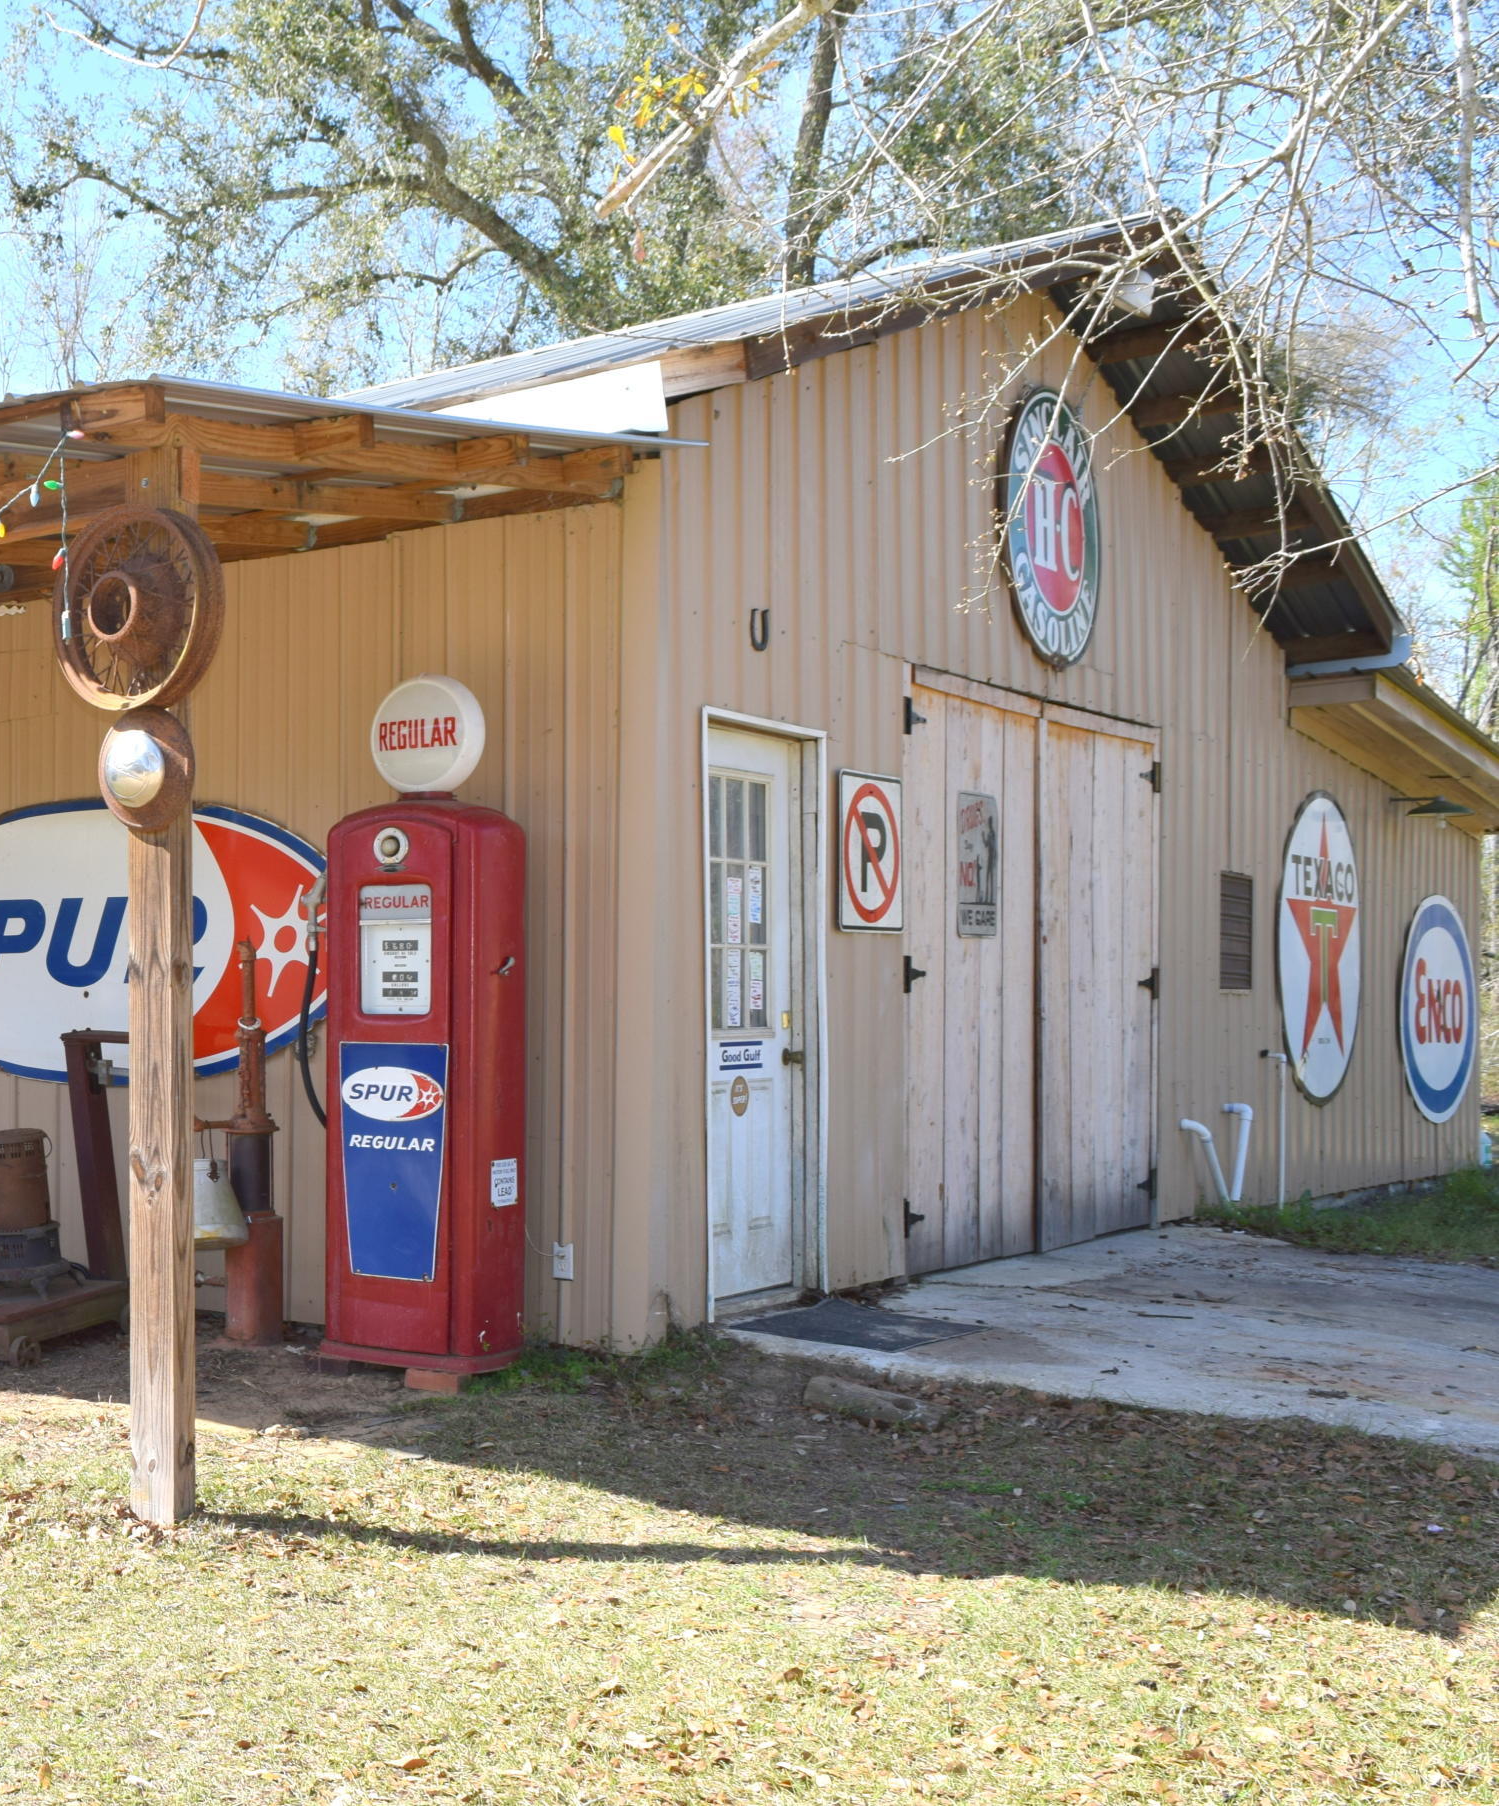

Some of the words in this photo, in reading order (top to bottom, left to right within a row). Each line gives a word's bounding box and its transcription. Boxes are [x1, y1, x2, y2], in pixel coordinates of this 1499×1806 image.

[1014, 401, 1091, 511] SINCLAIR
[1014, 551, 1094, 656] GASOLINE
[379, 716, 457, 751] REGULAR
[861, 811, 887, 893] P
[1291, 853, 1356, 904] TEXACO
[364, 895, 429, 909] REGULAR
[1310, 905, 1339, 1003] T
[722, 1050, 741, 1062] Good
[743, 1048, 761, 1061] Gulf
[349, 1083, 415, 1103] SPUR
[349, 1134, 436, 1152] REGULAR
